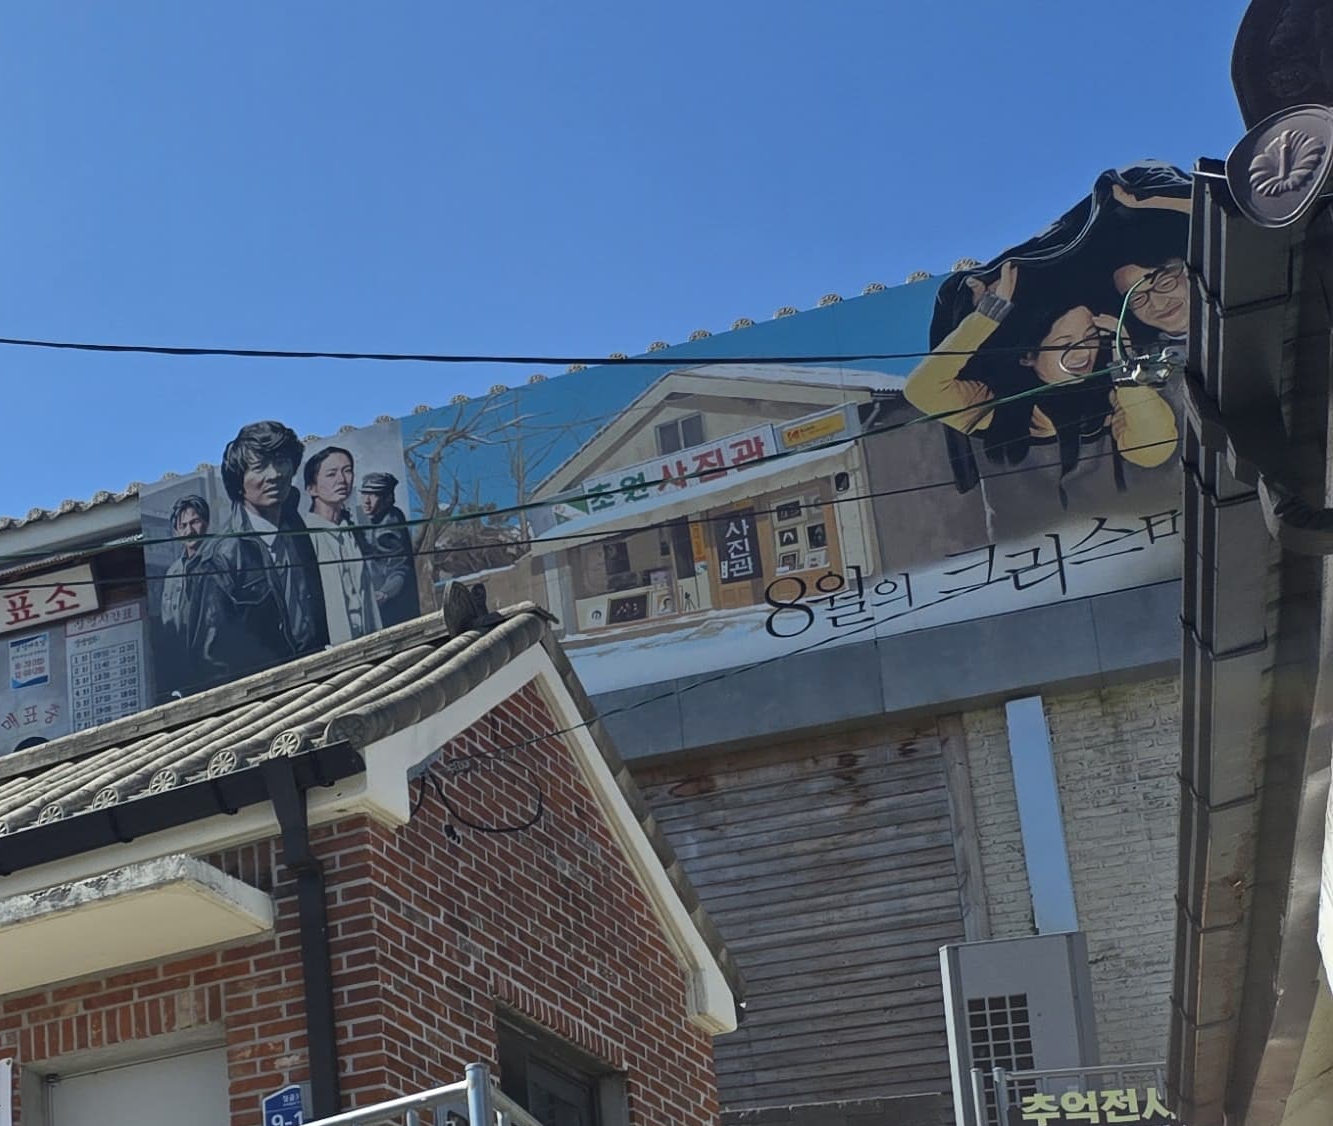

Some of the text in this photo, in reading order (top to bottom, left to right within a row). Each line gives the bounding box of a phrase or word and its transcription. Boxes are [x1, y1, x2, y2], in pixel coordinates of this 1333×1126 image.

[588, 436, 765, 512] 초원 사진관
[725, 519, 753, 577] 사진관
[764, 565, 913, 638] 8월의
[1022, 1087, 1177, 1126] 추억전시
